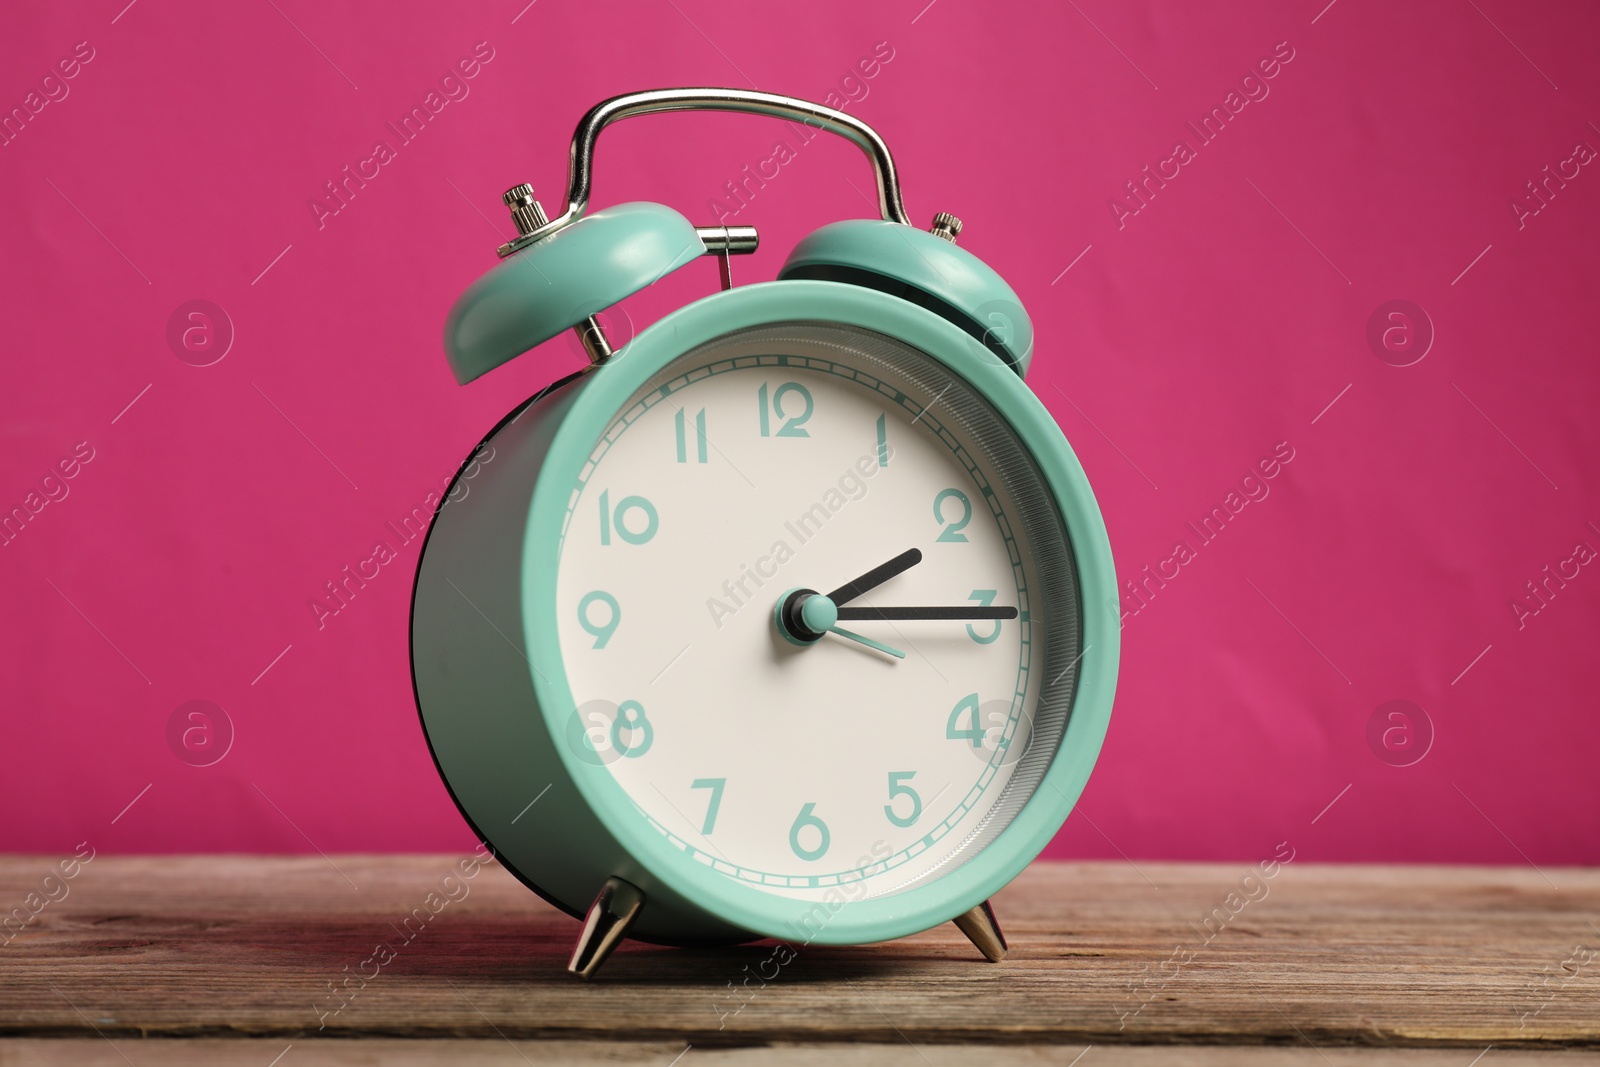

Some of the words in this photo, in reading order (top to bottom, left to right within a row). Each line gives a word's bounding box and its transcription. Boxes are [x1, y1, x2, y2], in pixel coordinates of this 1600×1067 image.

[675, 406, 708, 463] 11
[758, 381, 814, 437] 12
[876, 412, 888, 467] 1
[599, 488, 659, 546] 10
[933, 488, 972, 542] 2
[577, 590, 621, 649] 9
[965, 590, 1002, 645] 3
[610, 700, 654, 758] 8
[946, 692, 987, 748] 4
[690, 778, 727, 835] 7
[884, 771, 922, 828] 5
[789, 802, 831, 861] 6
